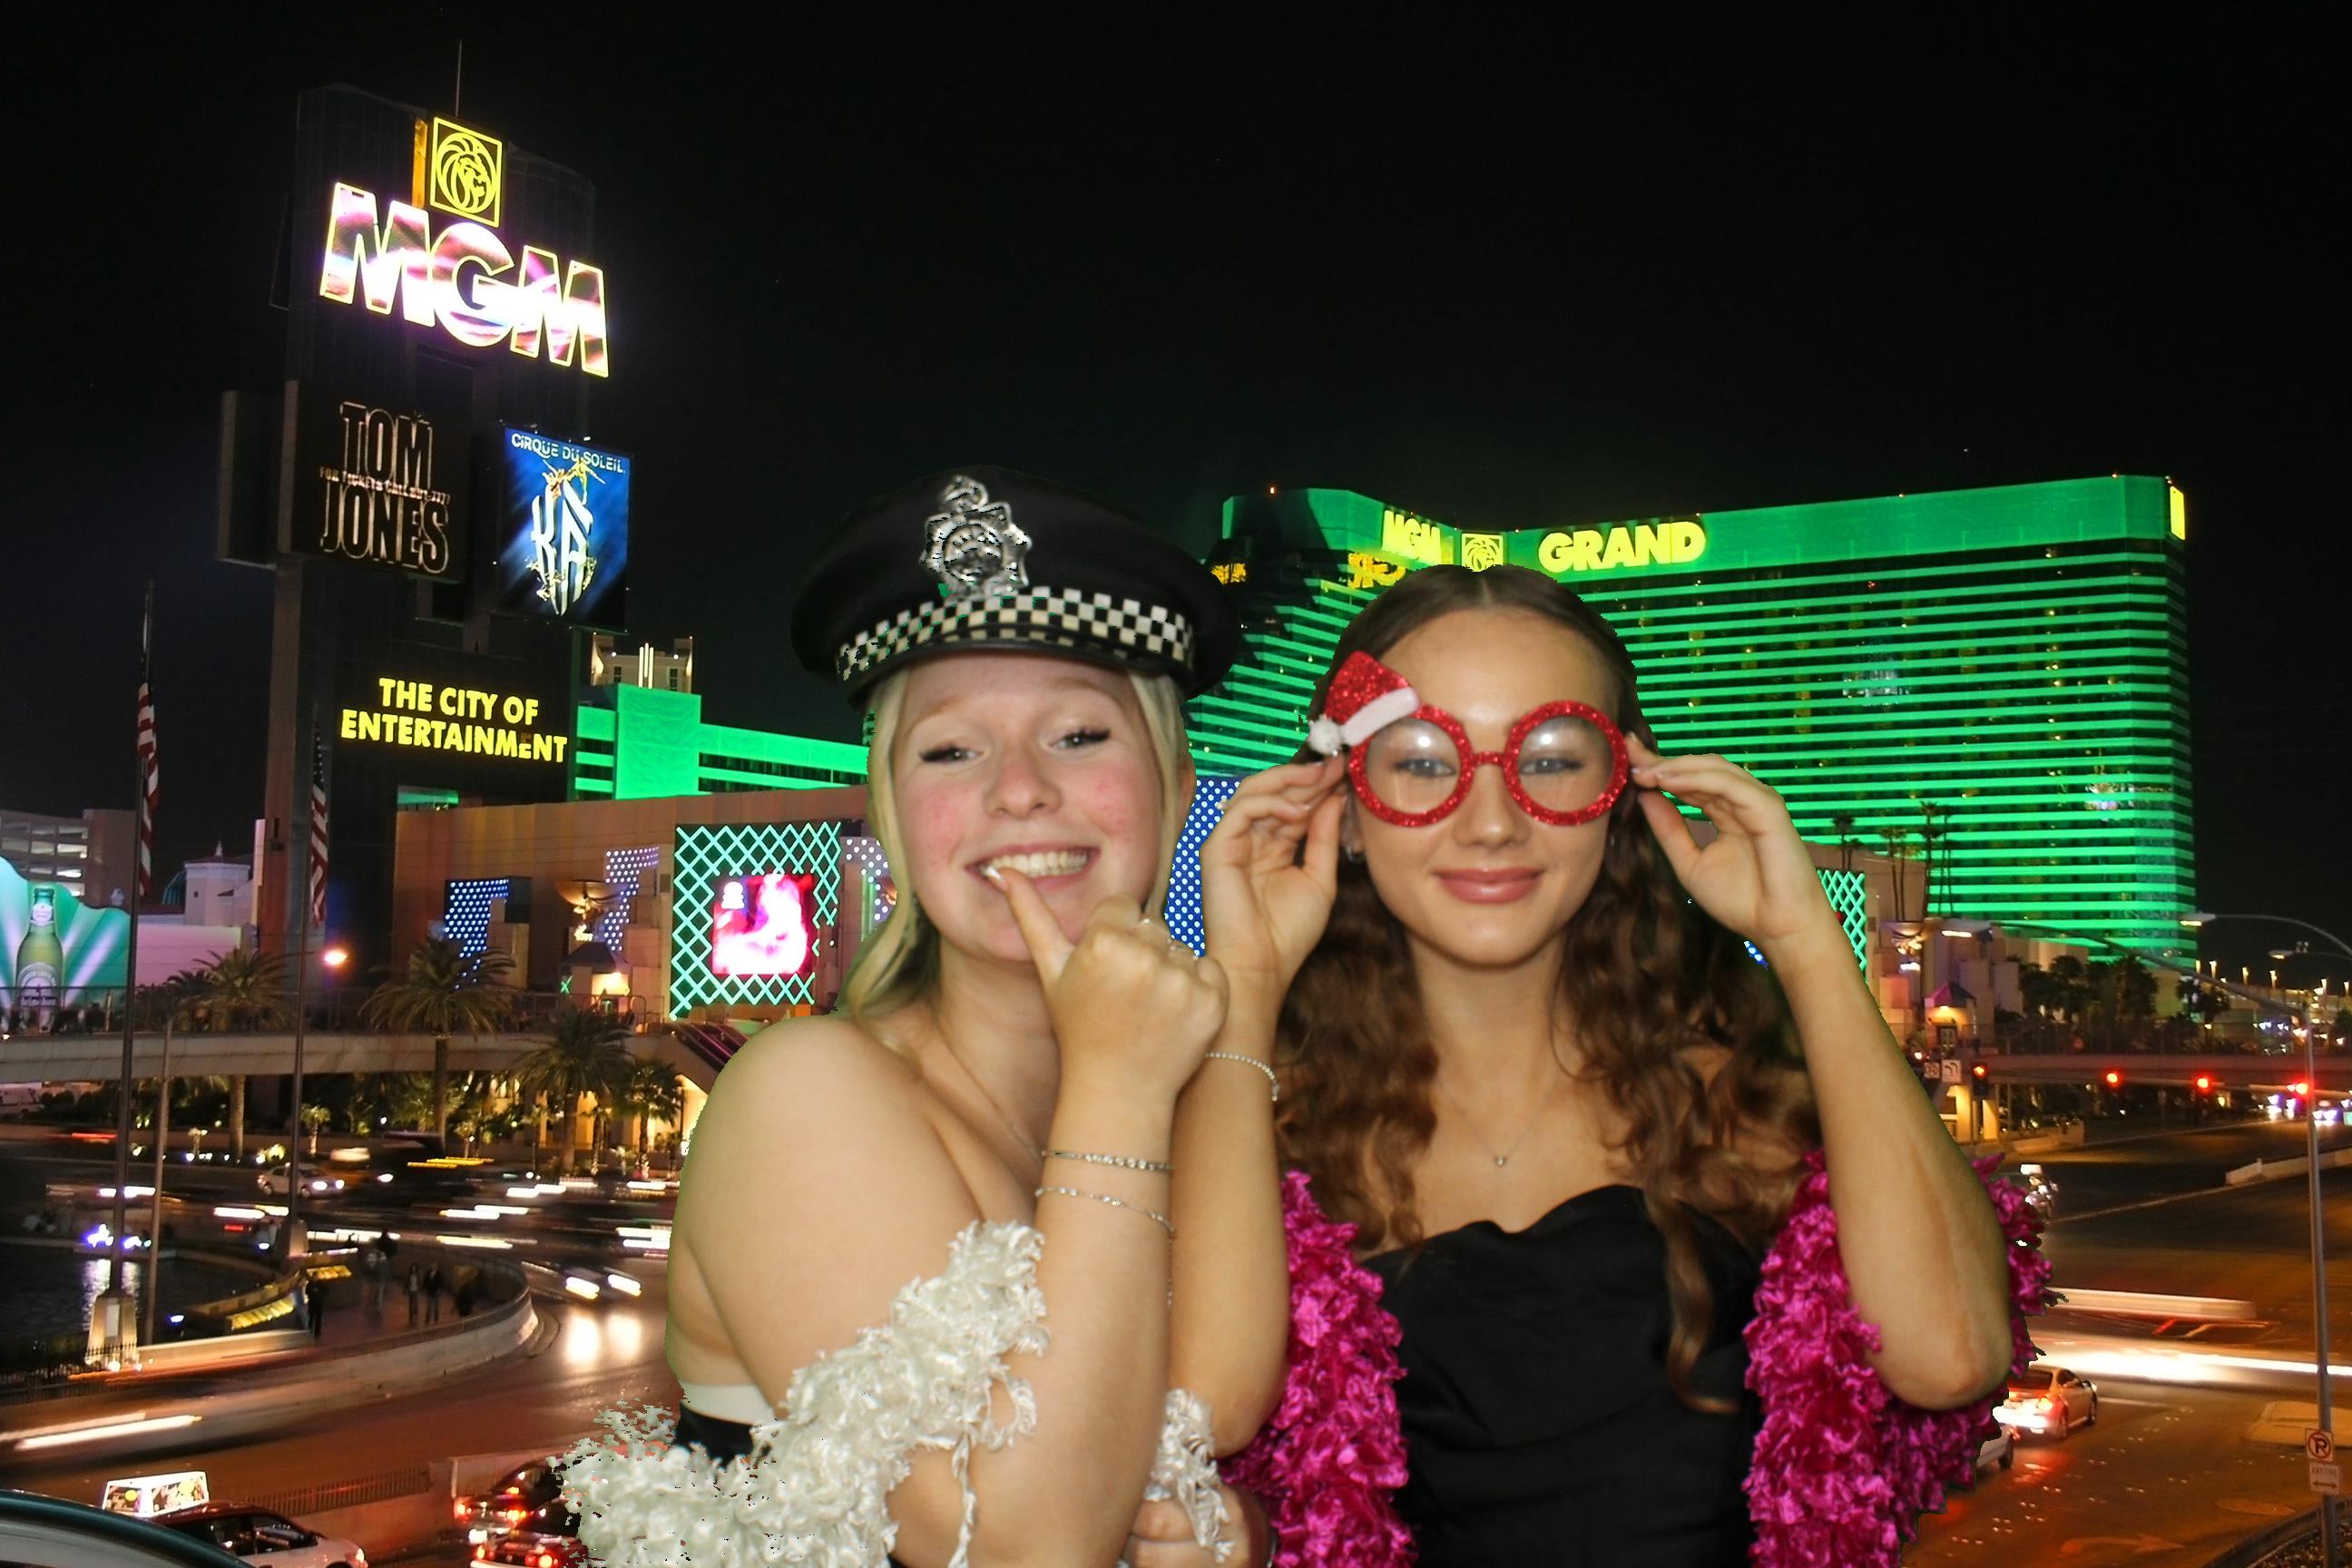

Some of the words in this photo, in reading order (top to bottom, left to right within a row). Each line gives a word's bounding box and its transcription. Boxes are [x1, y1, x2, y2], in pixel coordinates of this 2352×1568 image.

[319, 182, 610, 377] MGM
[339, 400, 433, 491] TOM
[511, 433, 559, 459] CIRQUE
[582, 451, 624, 474] SOLEIL
[320, 481, 449, 573] JONES
[1382, 509, 1441, 565] MGM
[1538, 521, 1706, 573] GRAND
[379, 678, 433, 711] THE
[439, 687, 498, 720] CITY
[503, 696, 539, 725] OF
[341, 709, 568, 762] ENTERTAINMENT
